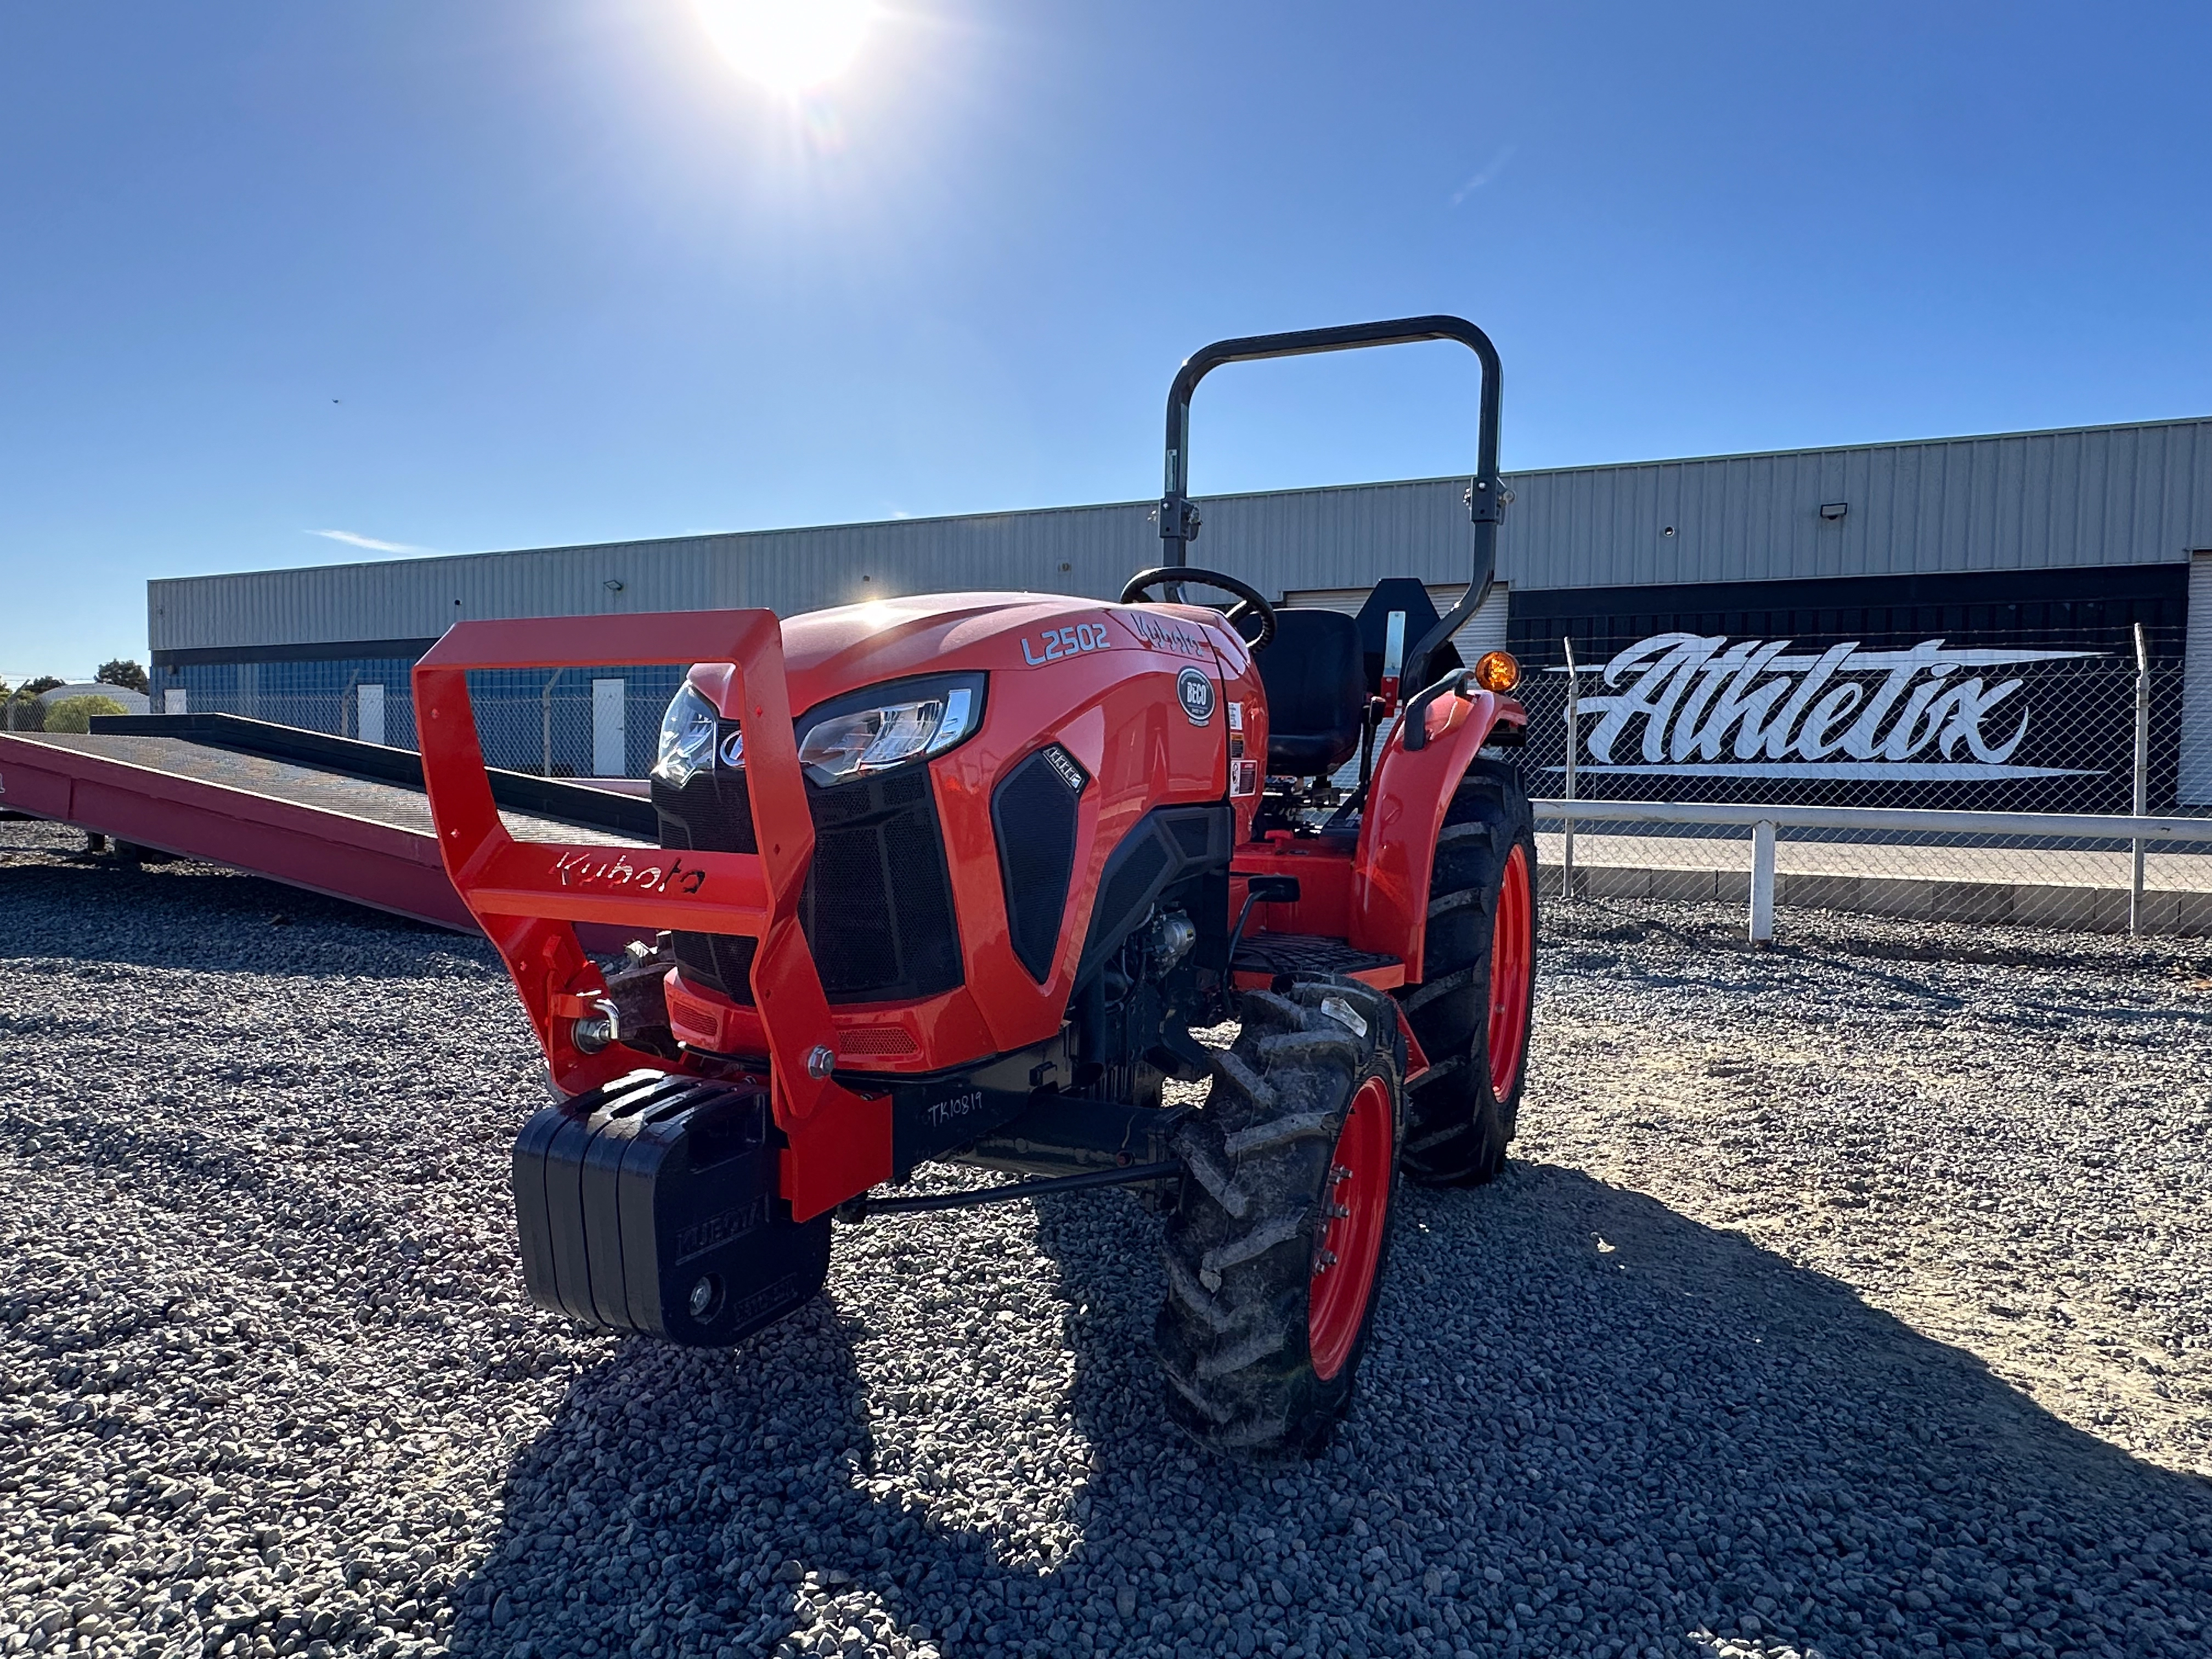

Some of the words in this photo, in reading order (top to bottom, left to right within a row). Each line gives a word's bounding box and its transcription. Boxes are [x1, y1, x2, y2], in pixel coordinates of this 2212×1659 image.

[1021, 623, 1111, 665] L2502
[1130, 613, 1204, 657] Kubota
[1187, 682, 1207, 706] BECO
[1564, 632, 2029, 764] Athletix
[549, 851, 706, 894] Kubota
[927, 1091, 982, 1128] TK10819
